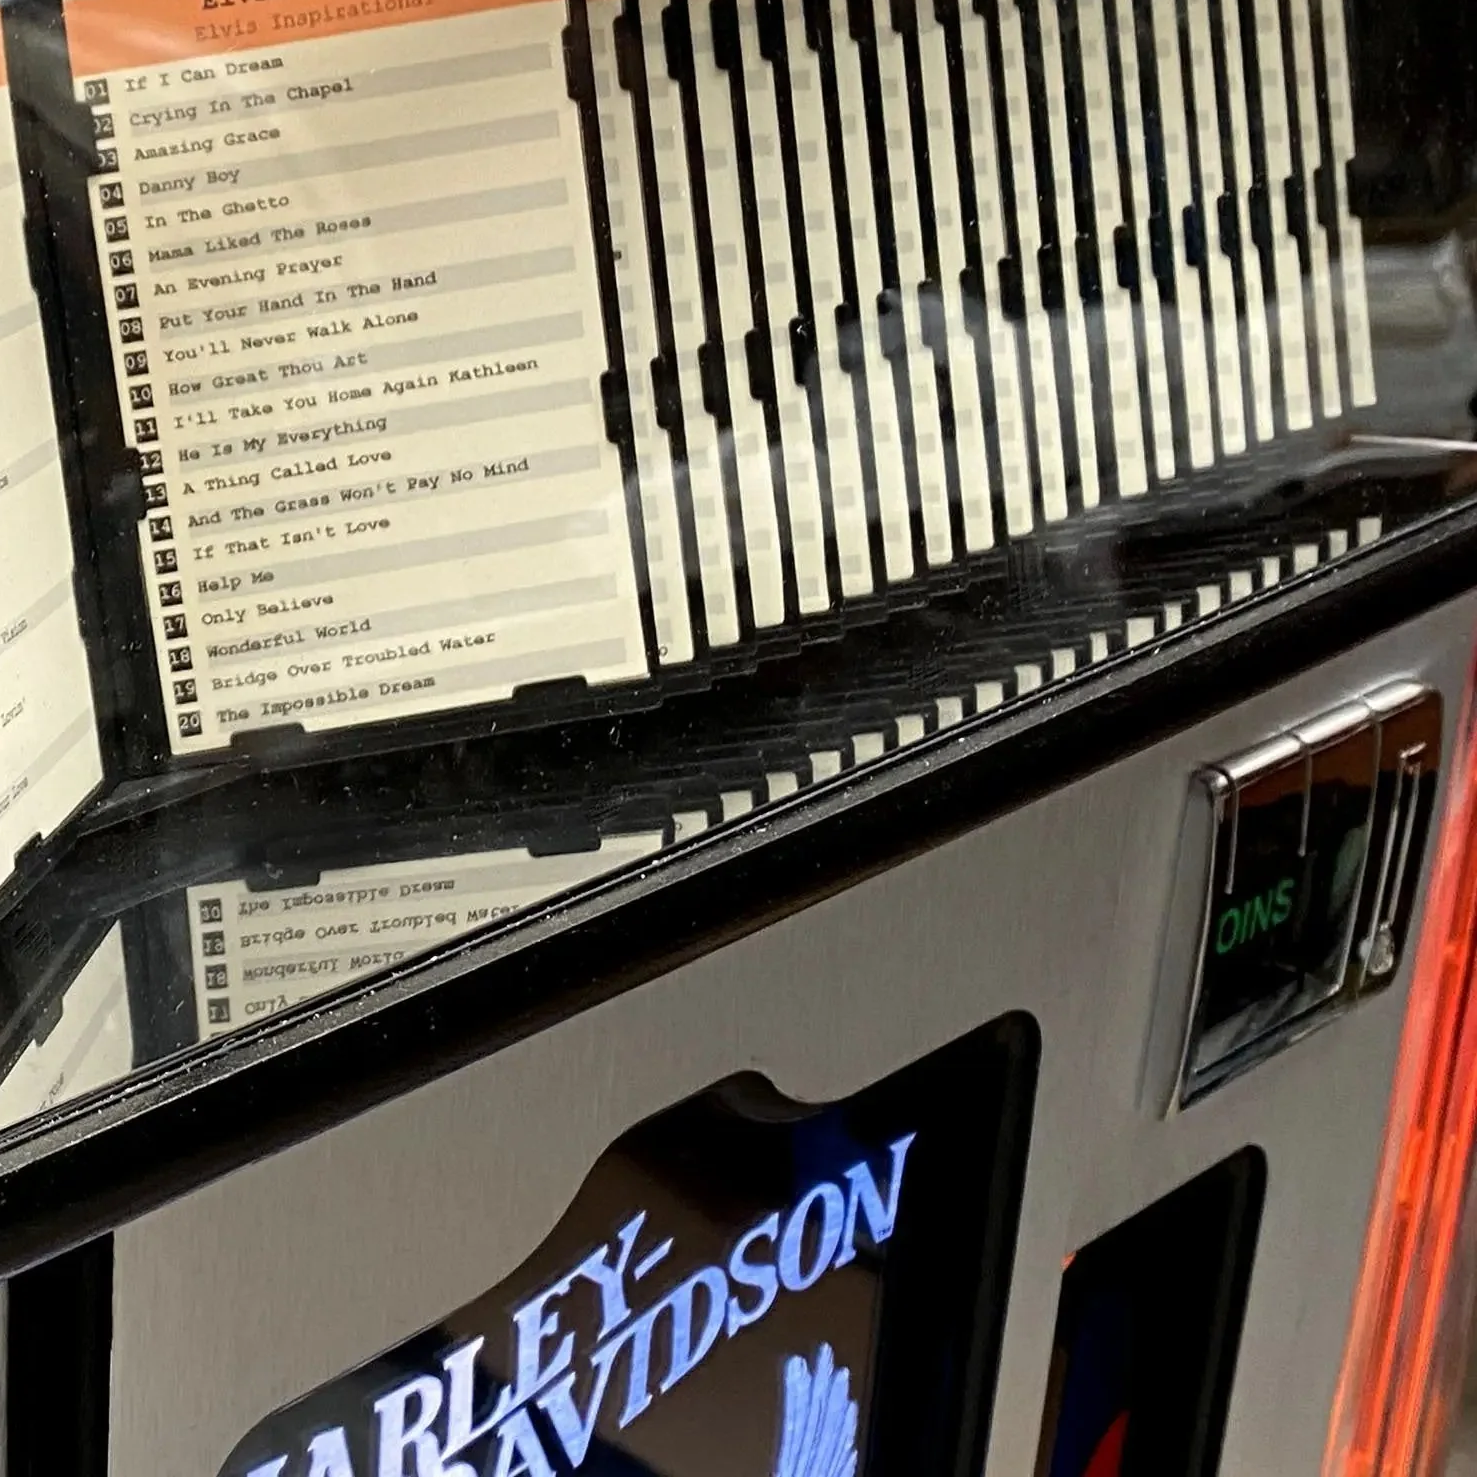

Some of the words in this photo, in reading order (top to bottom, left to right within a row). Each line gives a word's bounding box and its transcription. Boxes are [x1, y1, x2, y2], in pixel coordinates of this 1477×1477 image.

[124, 75, 147, 93] If
[159, 72, 171, 87] I
[180, 68, 217, 84] Can
[225, 57, 285, 76] Dream
[128, 105, 198, 129] Crying
[207, 99, 233, 115] In
[240, 92, 277, 109] The
[286, 77, 354, 102] Chapel
[134, 138, 214, 162] Amazing
[223, 127, 281, 147] Grace
[100, 186, 122, 201] 04
[138, 175, 196, 196] Danny
[205, 168, 241, 185] Boy
[105, 220, 127, 235] 05
[144, 215, 168, 229] In
[176, 208, 213, 224] The
[221, 195, 290, 217] Ghetto
[110, 254, 132, 268] 06
[147, 245, 195, 264] Mama
[204, 231, 262, 254] Liked
[270, 226, 306, 243] The
[315, 216, 372, 237] Roses
[116, 288, 137, 302] 07
[153, 283, 178, 297] An
[187, 268, 266, 291] Evening
[275, 254, 343, 277] Prayer
[121, 321, 142, 335] 08
[158, 313, 193, 331] Put
[201, 305, 249, 323] Your
[257, 292, 305, 314] Hand
[313, 289, 338, 305] In
[346, 283, 381, 299] The
[391, 270, 438, 292] Hand
[126, 354, 147, 369] 09
[162, 339, 231, 363] You'll
[240, 331, 296, 351] Never
[306, 319, 353, 339] Walk
[362, 311, 419, 331] Alone
[131, 388, 152, 402] 10
[168, 382, 202, 397] How
[211, 368, 269, 390] Great
[277, 360, 325, 379] Thou
[333, 351, 369, 371] Art
[136, 421, 157, 435] 11
[173, 410, 218, 430] I'll
[227, 403, 274, 420] Take
[283, 395, 318, 411] You
[327, 387, 373, 404] Home
[382, 375, 439, 396] Again
[448, 359, 539, 384] Kathleen
[141, 454, 162, 468] 12
[178, 448, 201, 463] He
[210, 443, 233, 459] Is
[242, 437, 267, 454] My
[276, 417, 387, 447] Everything
[146, 486, 166, 501] 13
[182, 482, 196, 496] A
[203, 472, 261, 492] Thing
[270, 456, 339, 481] Called
[346, 450, 392, 468] Love
[151, 519, 171, 534] 14
[187, 510, 223, 529] And
[229, 505, 265, 522] The
[274, 494, 331, 514] Grass
[339, 481, 397, 503] Won't
[406, 475, 440, 492] Pay
[449, 468, 474, 485] No
[482, 457, 530, 479] Mind
[156, 552, 176, 566] 15
[192, 544, 215, 561] If
[224, 537, 271, 555] That
[280, 525, 337, 546] Isn't
[344, 518, 391, 535] Love
[160, 584, 181, 599] 16
[197, 575, 242, 594] Help
[250, 570, 275, 585] Me
[165, 617, 186, 631] 17
[200, 608, 247, 627] Only
[256, 595, 334, 617] Believe
[170, 649, 191, 664] 18
[205, 629, 306, 659] Wonderful
[314, 618, 373, 640] World
[175, 681, 195, 696] 19
[211, 670, 279, 691] Bridge
[286, 660, 332, 678] Over
[341, 640, 432, 668] Troubled
[438, 632, 496, 652] Water
[180, 713, 200, 728] 20
[215, 707, 251, 724] The
[260, 686, 370, 717] Impossible
[378, 676, 436, 696] Dream
[429, 1132, 916, 1477] AVIDSON
[246, 1210, 674, 1477] ARLEY-
